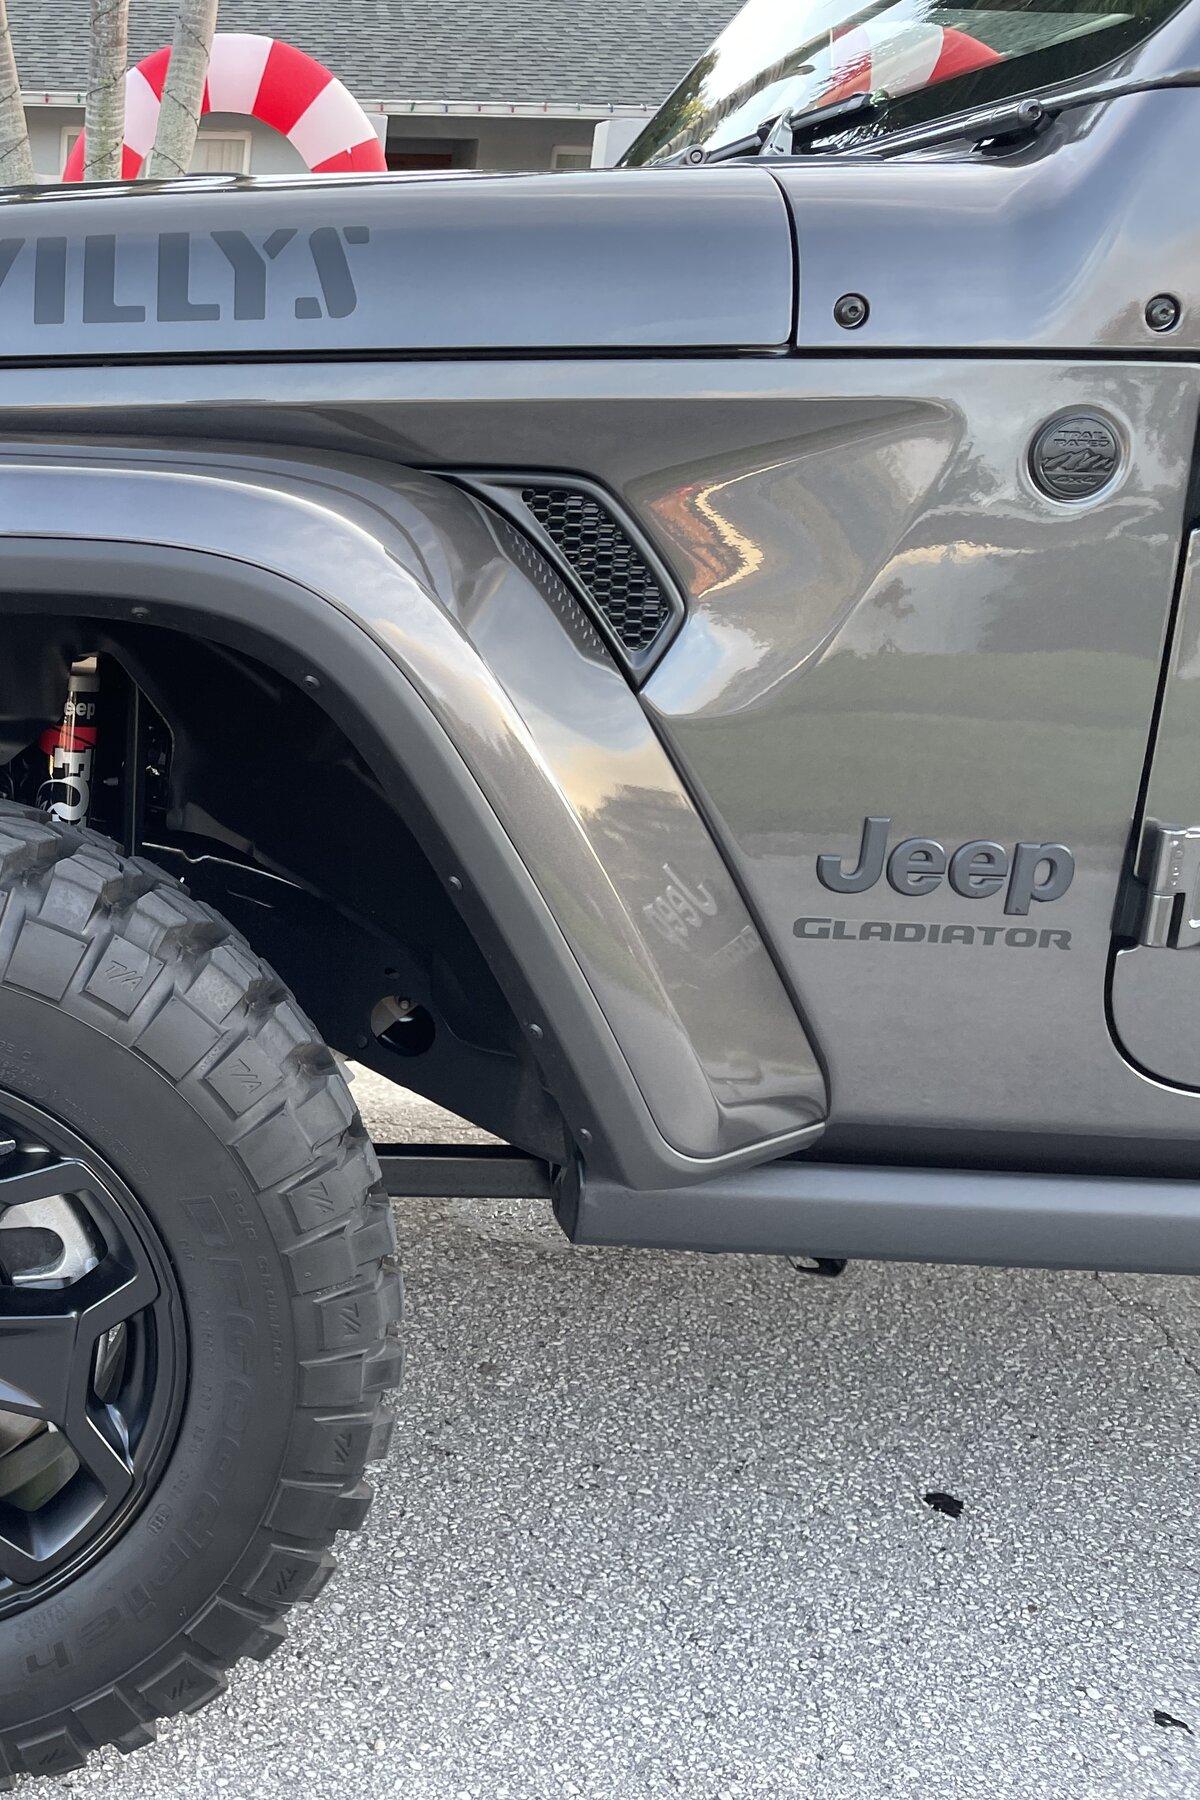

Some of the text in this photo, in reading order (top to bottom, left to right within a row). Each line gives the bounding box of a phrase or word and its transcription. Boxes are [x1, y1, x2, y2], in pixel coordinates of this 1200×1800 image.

[1053, 438, 1110, 447] RATED
[1058, 430, 1107, 439] TRAIL
[64, 701, 96, 720] eep
[816, 816, 1075, 915] Jeep
[792, 917, 1072, 950] GLADIATOR
